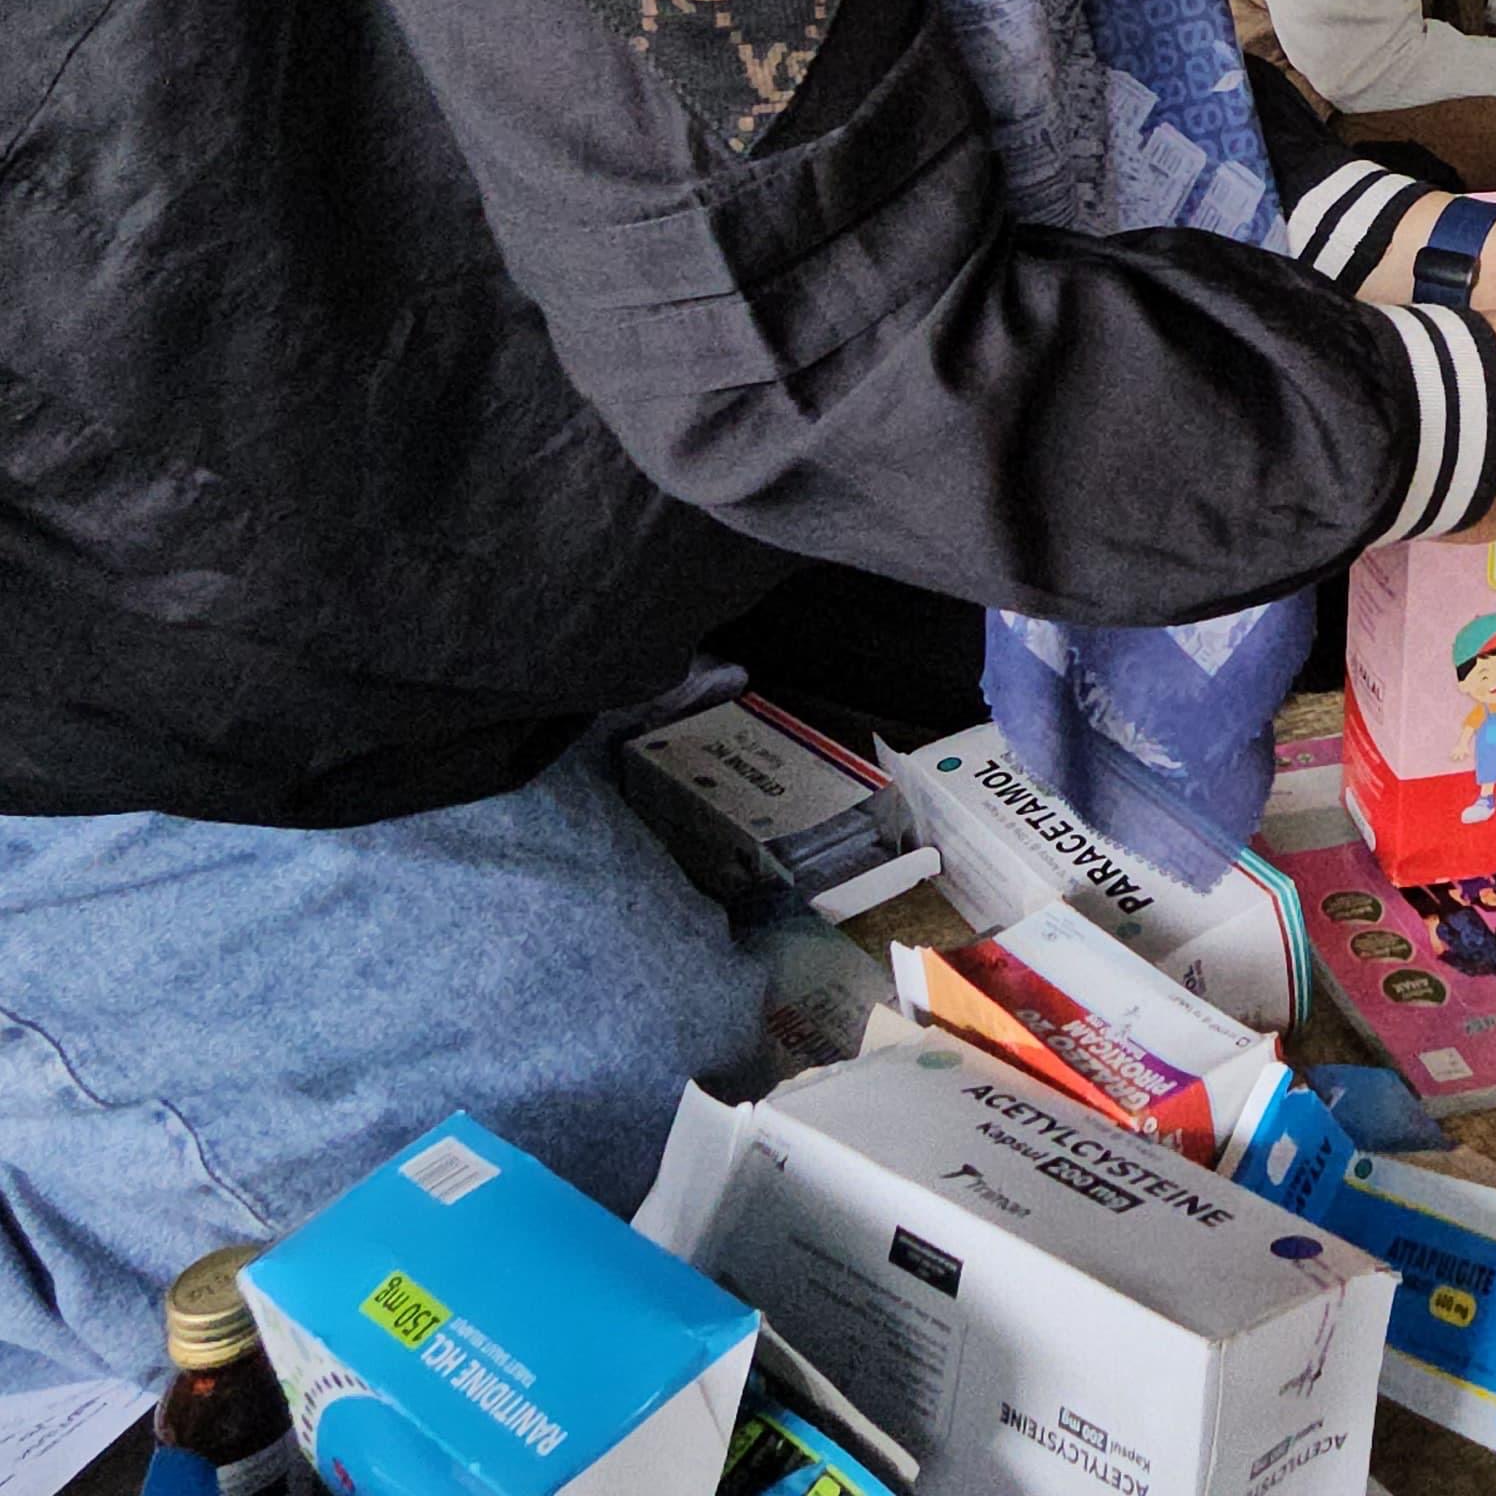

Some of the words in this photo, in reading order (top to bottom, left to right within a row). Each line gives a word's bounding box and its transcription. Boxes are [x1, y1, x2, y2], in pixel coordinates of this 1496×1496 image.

[974, 759, 1155, 915] PARACETAMOL
[1048, 1034, 1151, 1112] GRAZEO
[1060, 1019, 1178, 1096] PIROXICAM
[961, 1084, 1235, 1228] ACETYLCYSTEINE
[975, 1121, 1049, 1161] Kapsul
[374, 1276, 410, 1312] mg
[393, 1303, 441, 1343] 150
[450, 1359, 568, 1457] RANITIDINE
[1000, 1401, 1150, 1496] ACETYLCYSTEINE
[1109, 1439, 1151, 1471] Kapsul
